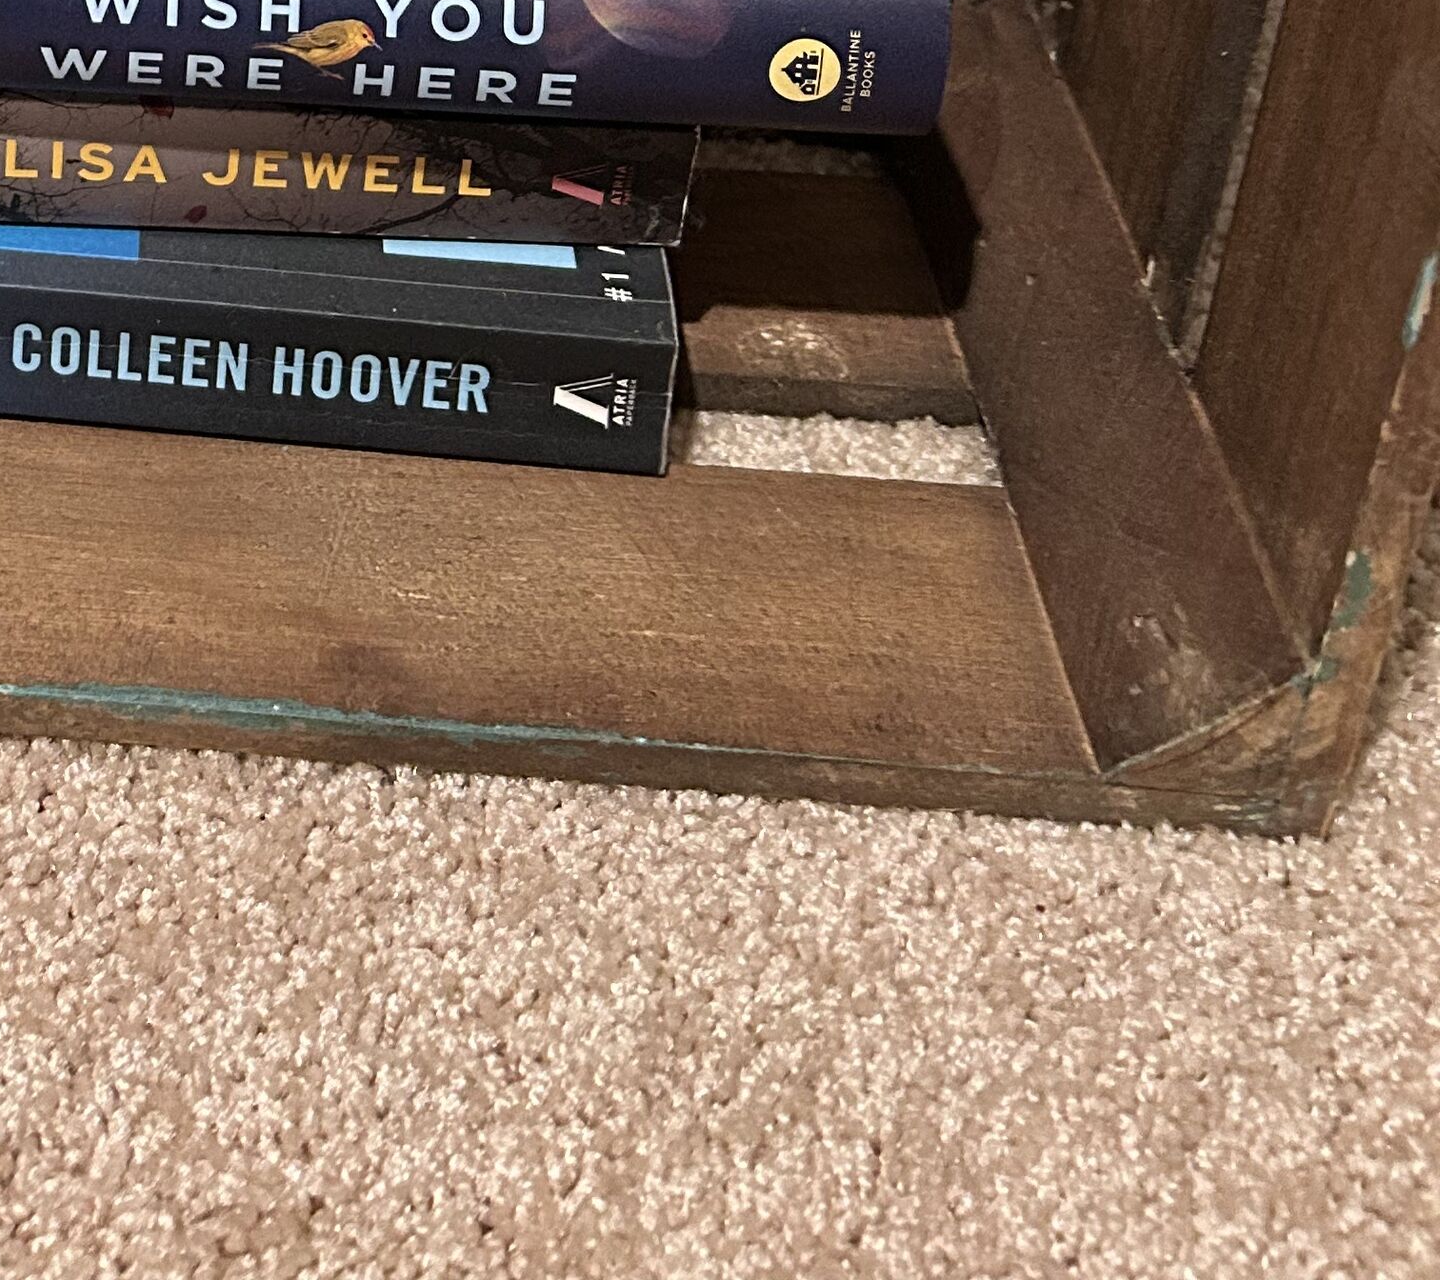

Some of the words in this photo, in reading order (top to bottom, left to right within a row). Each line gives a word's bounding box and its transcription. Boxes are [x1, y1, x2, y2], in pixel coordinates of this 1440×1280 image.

[39, 46, 284, 91] WERE
[352, 63, 579, 107] HERE
[841, 30, 861, 112] BALLANTINE
[860, 51, 876, 97] BOOKS
[4, 140, 167, 185] LISA
[202, 148, 492, 198] JEWELL
[610, 165, 628, 206] ATRIA
[601, 271, 633, 302] #1
[11, 322, 249, 391] COLLEEN
[271, 345, 492, 415] HOOVER
[612, 378, 630, 427] ATRIA
